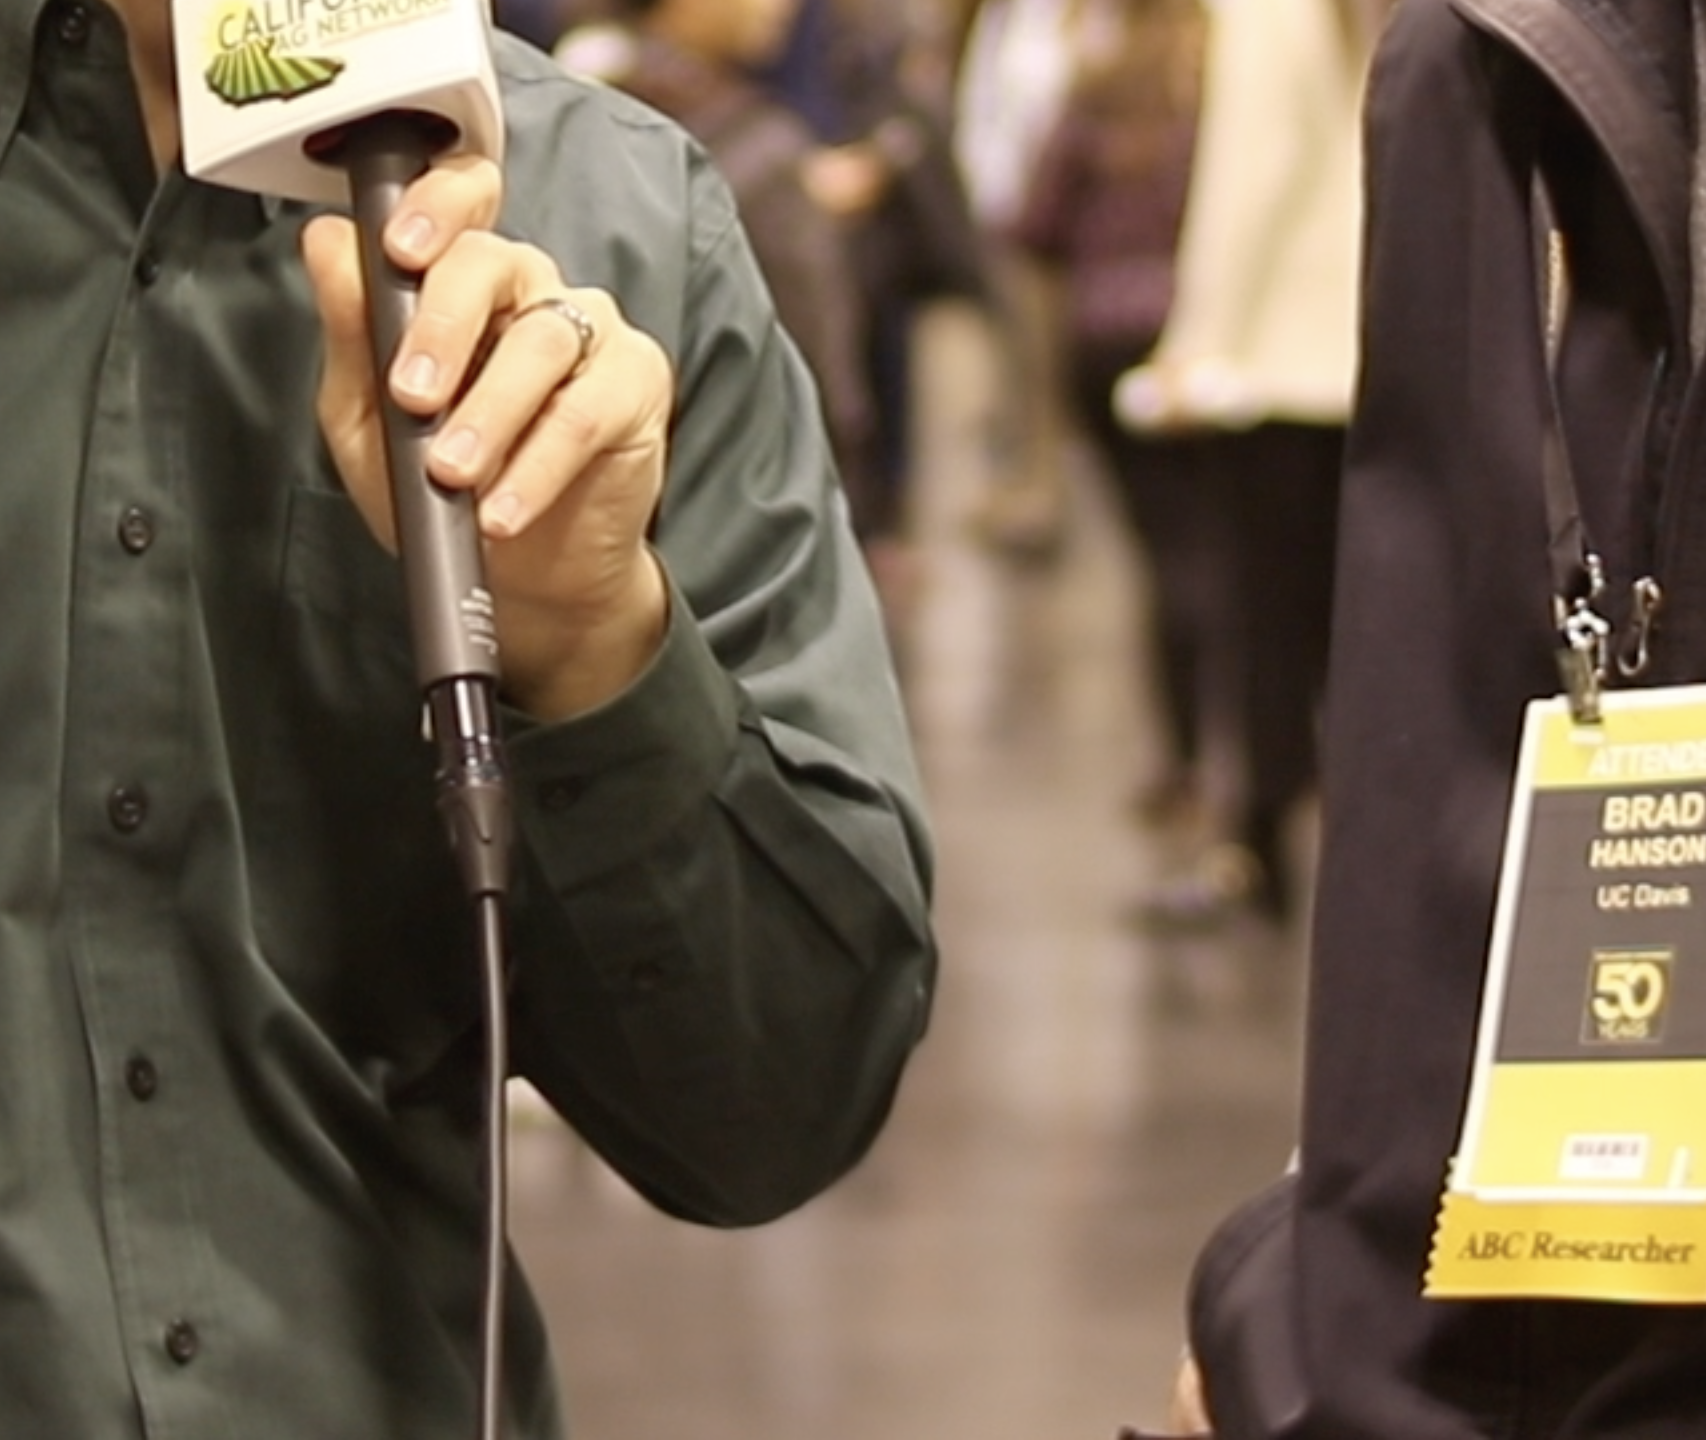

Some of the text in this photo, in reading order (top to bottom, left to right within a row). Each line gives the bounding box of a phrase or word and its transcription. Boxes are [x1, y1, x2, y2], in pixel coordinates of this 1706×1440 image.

[1597, 883, 1691, 909] UC Davis
[1593, 961, 1664, 1020] 50
[1458, 1231, 1695, 1264] ABC Researcher
